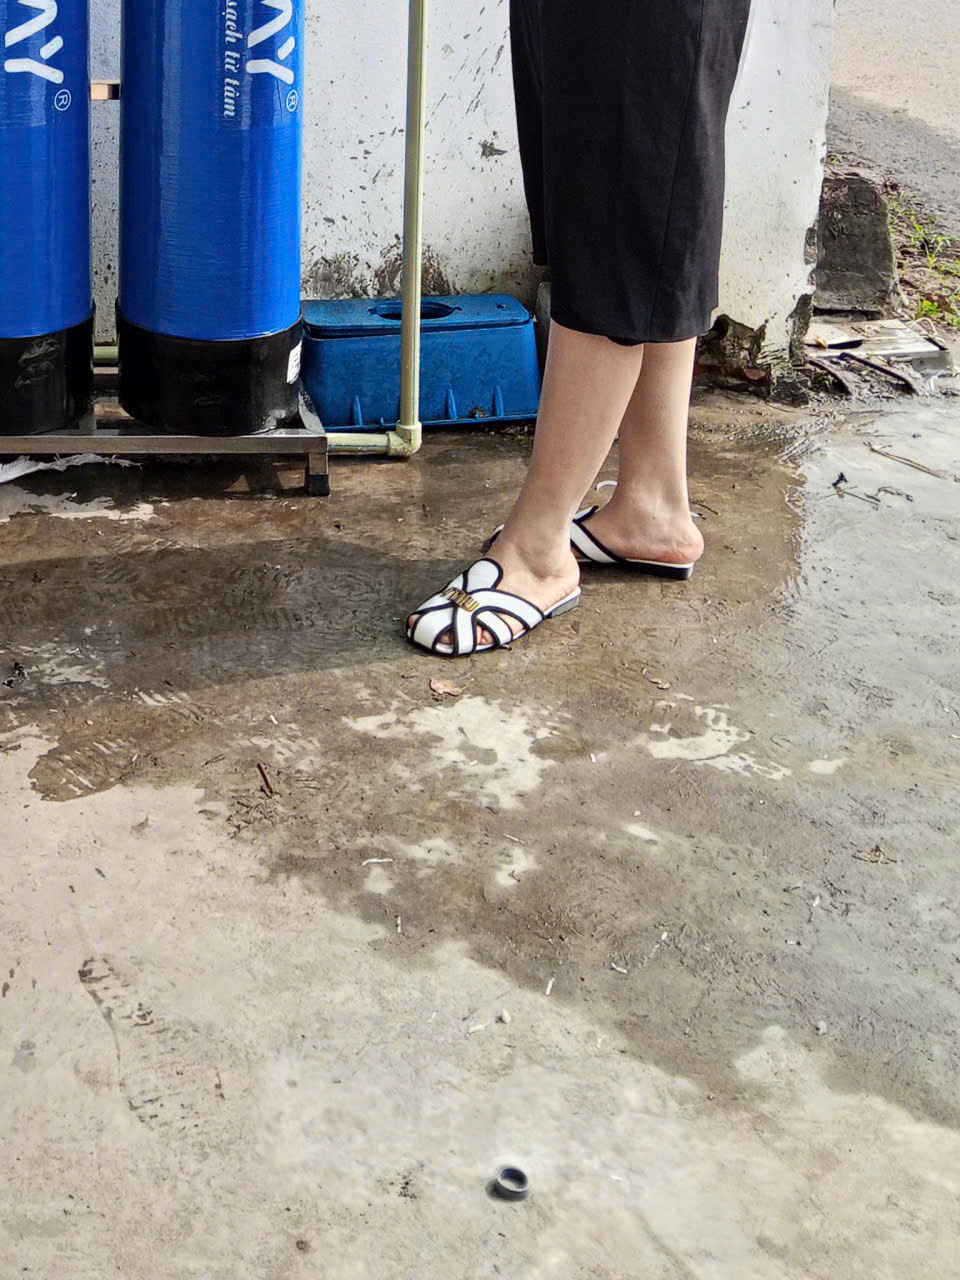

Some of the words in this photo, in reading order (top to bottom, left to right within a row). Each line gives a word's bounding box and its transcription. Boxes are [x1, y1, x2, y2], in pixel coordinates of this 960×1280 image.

[221, 0, 245, 42] sạch
[224, 46, 242, 74] từ
[223, 78, 241, 118] tâm
